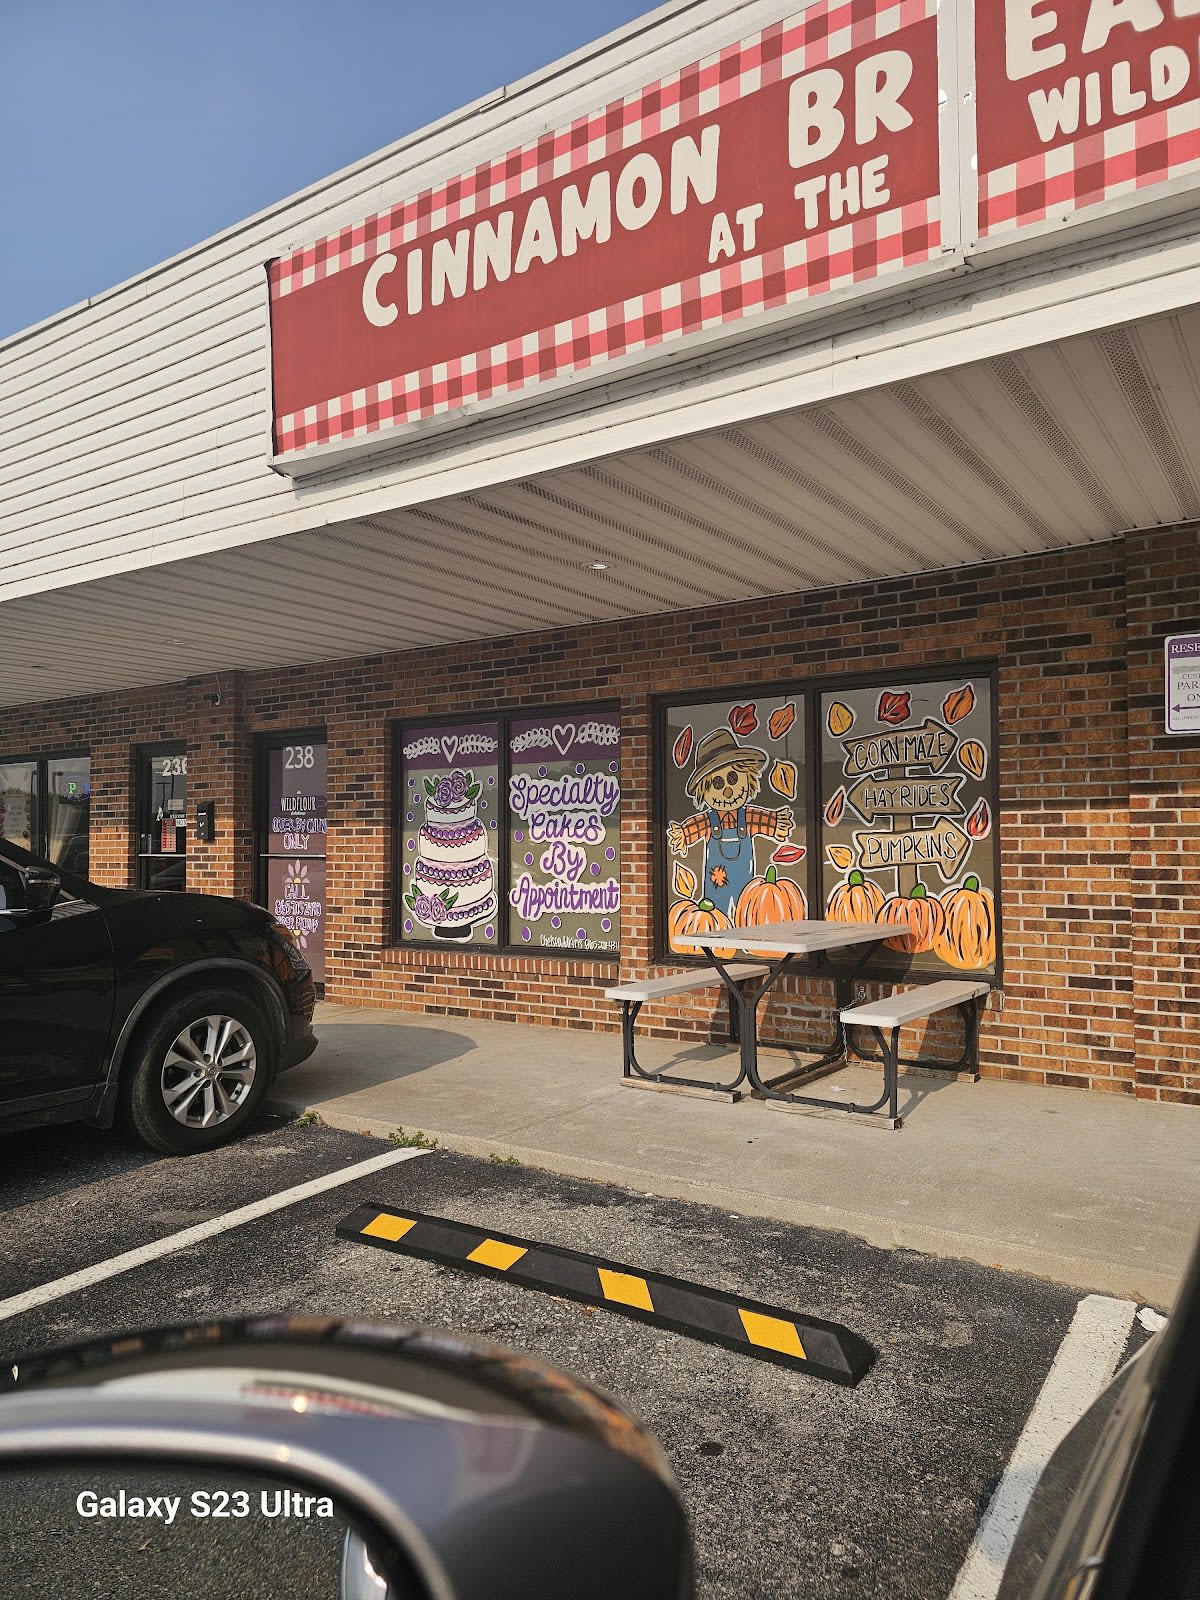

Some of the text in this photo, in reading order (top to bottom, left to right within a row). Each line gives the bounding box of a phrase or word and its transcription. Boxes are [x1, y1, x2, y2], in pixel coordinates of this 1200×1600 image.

[708, 34, 1200, 263] AT THE WILD
[362, 125, 721, 328] CINNAMON
[788, 50, 914, 168] BR
[285, 745, 315, 769] 238
[854, 731, 949, 766] CORN MAZE
[281, 797, 316, 811] WILDFLOUR
[510, 776, 619, 817] Specialty
[284, 833, 310, 850] ONLY
[531, 812, 603, 842] Cakes
[543, 841, 583, 881] By
[867, 831, 957, 863] PUMPKINS
[284, 884, 310, 899] CALL
[511, 877, 619, 918] Appointment
